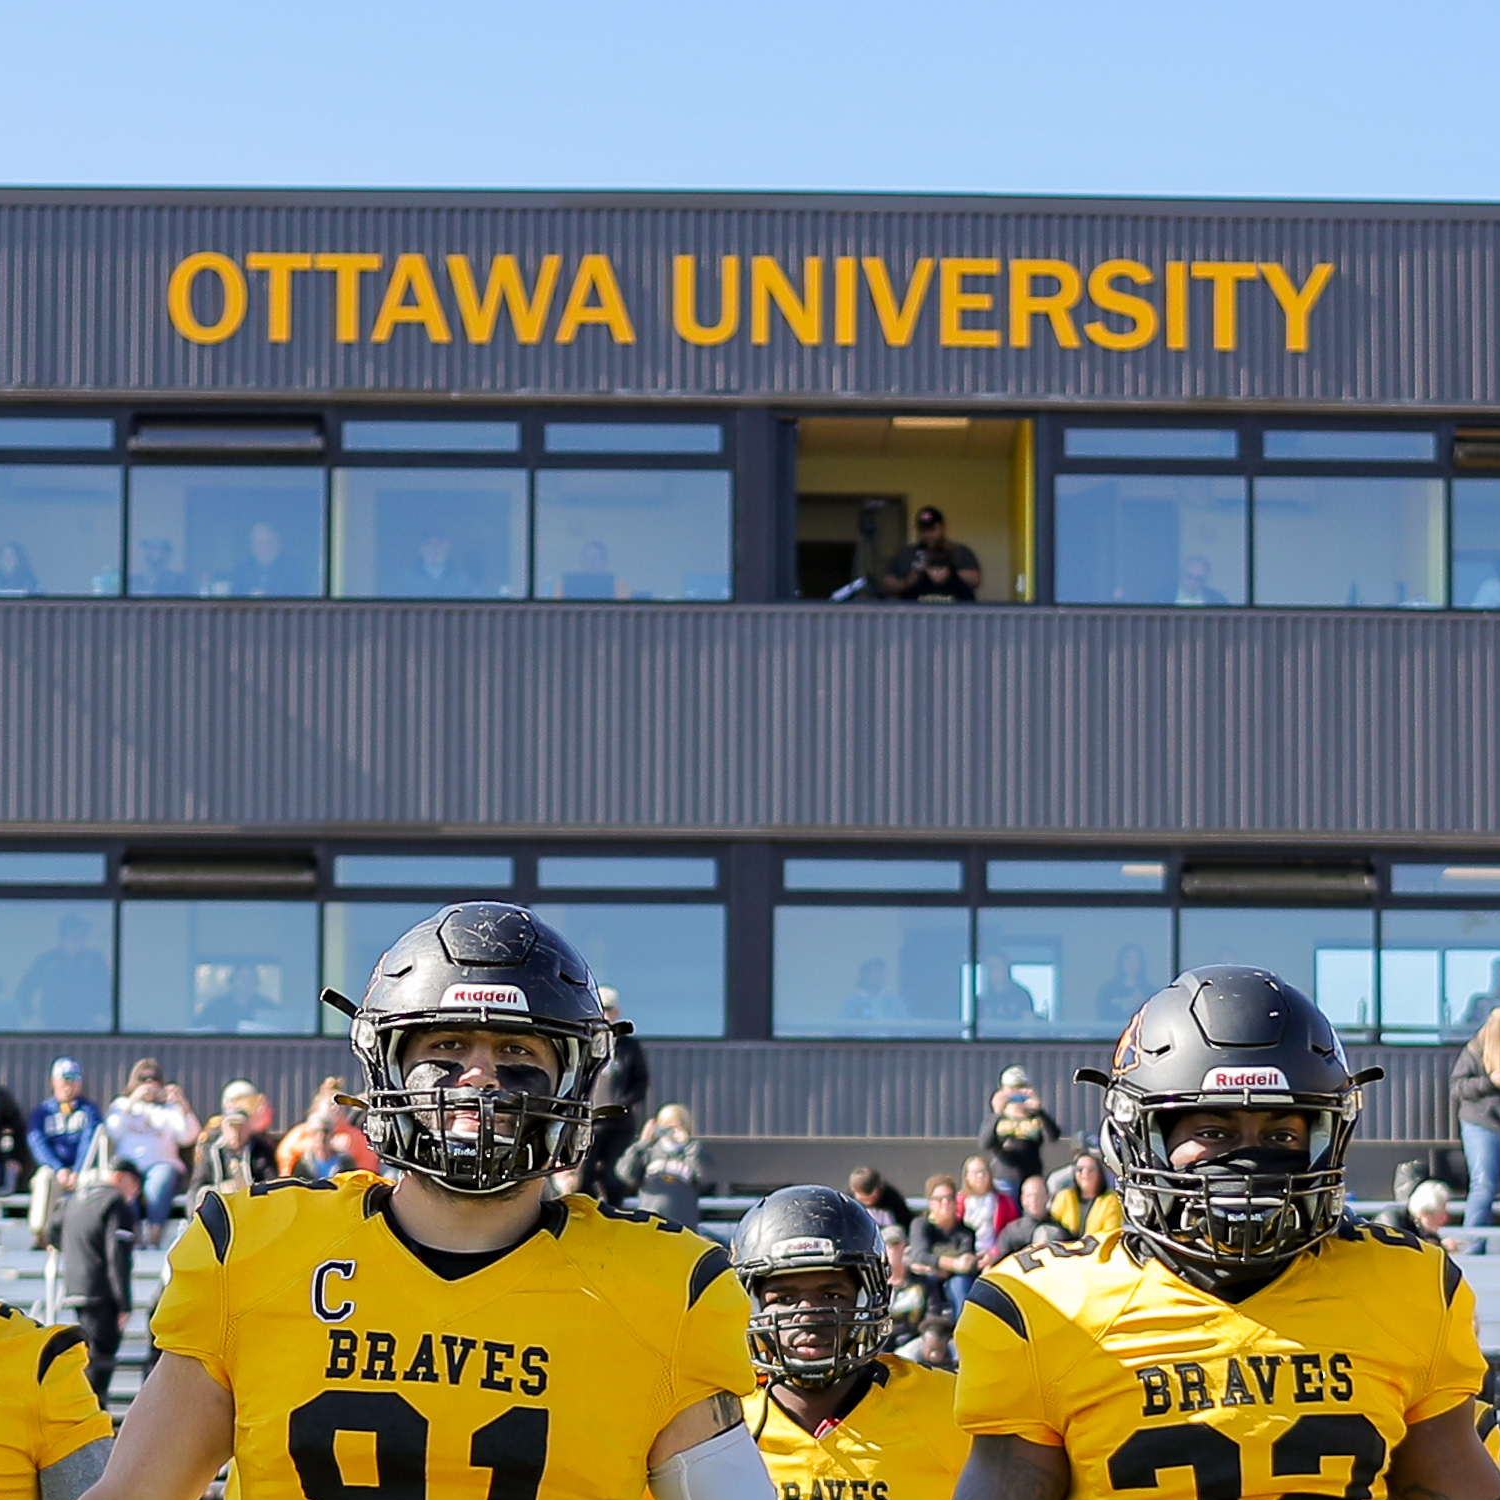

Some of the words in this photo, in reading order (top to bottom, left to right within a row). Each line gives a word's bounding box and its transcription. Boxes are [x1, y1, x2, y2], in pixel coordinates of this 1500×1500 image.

[168, 252, 635, 345] OTTAWA
[674, 255, 1334, 352] UNIVERSITY
[454, 989, 518, 1004] Riddell
[1215, 1072, 1279, 1087] Riddell
[313, 1260, 355, 1322] C
[324, 1329, 549, 1397] BRAVES
[1137, 1353, 1354, 1417] BRAVES
